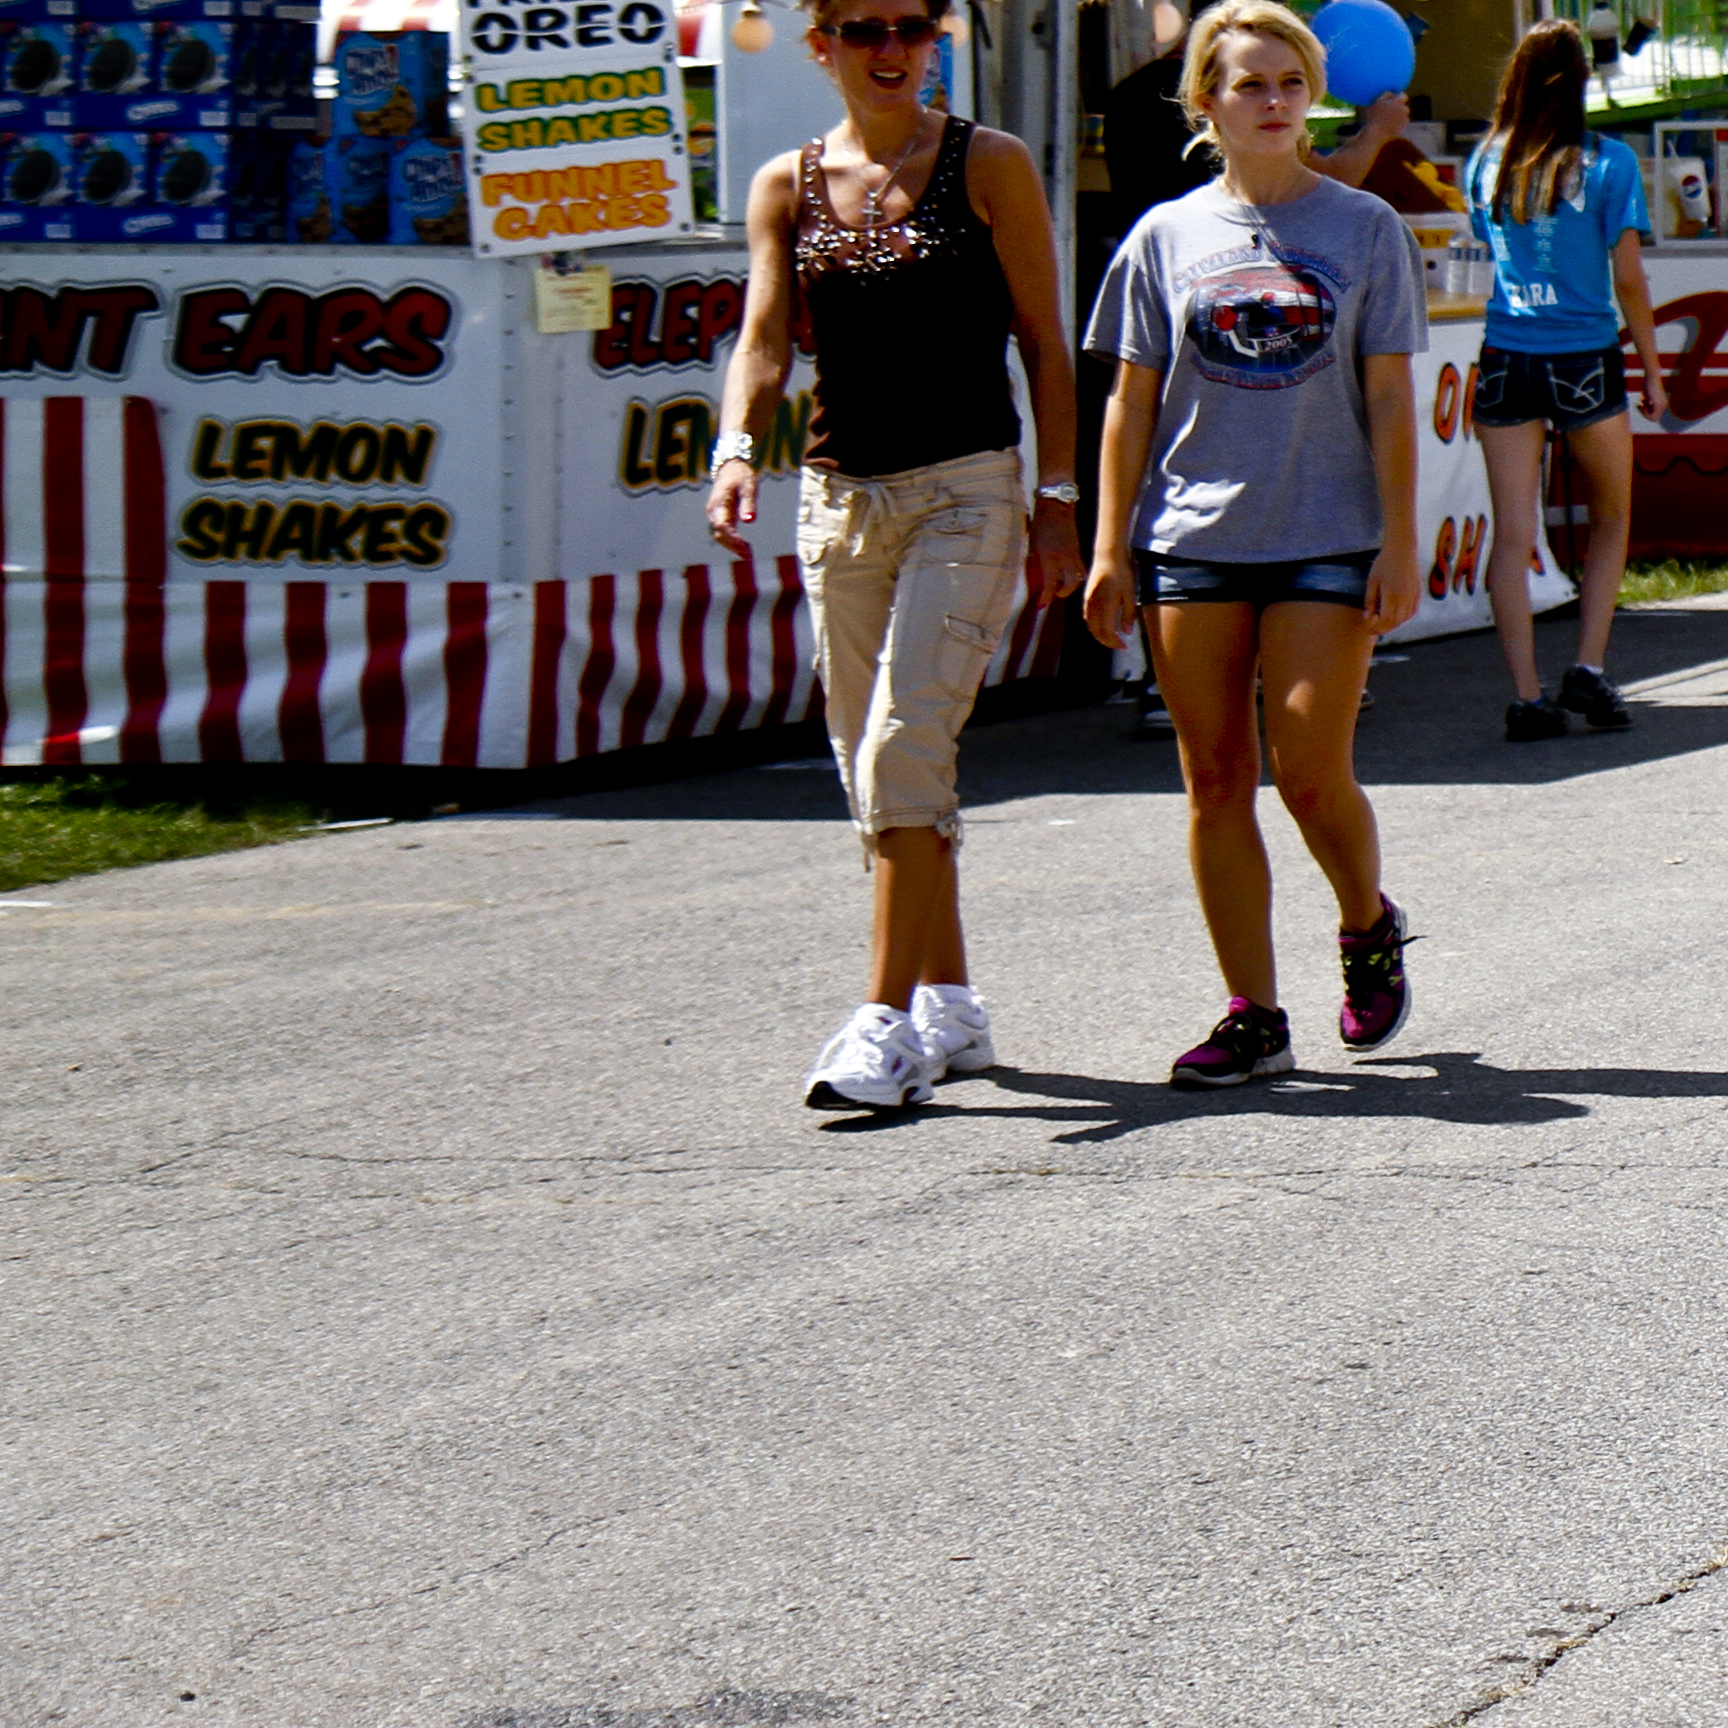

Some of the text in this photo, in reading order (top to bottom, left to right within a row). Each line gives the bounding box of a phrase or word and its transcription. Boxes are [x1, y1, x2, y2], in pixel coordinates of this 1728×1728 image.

[471, 2, 665, 55] OREO
[475, 66, 667, 113] LEMON
[476, 106, 671, 152] SHAKES
[480, 158, 678, 206] FUNNEL
[493, 193, 670, 242] CAKES
[0, 284, 158, 376] NT
[172, 281, 453, 378] EARS
[592, 275, 817, 370] ELEP
[190, 419, 437, 486] LEMON
[621, 392, 813, 489] LEMN
[175, 498, 451, 566] SHAKES
